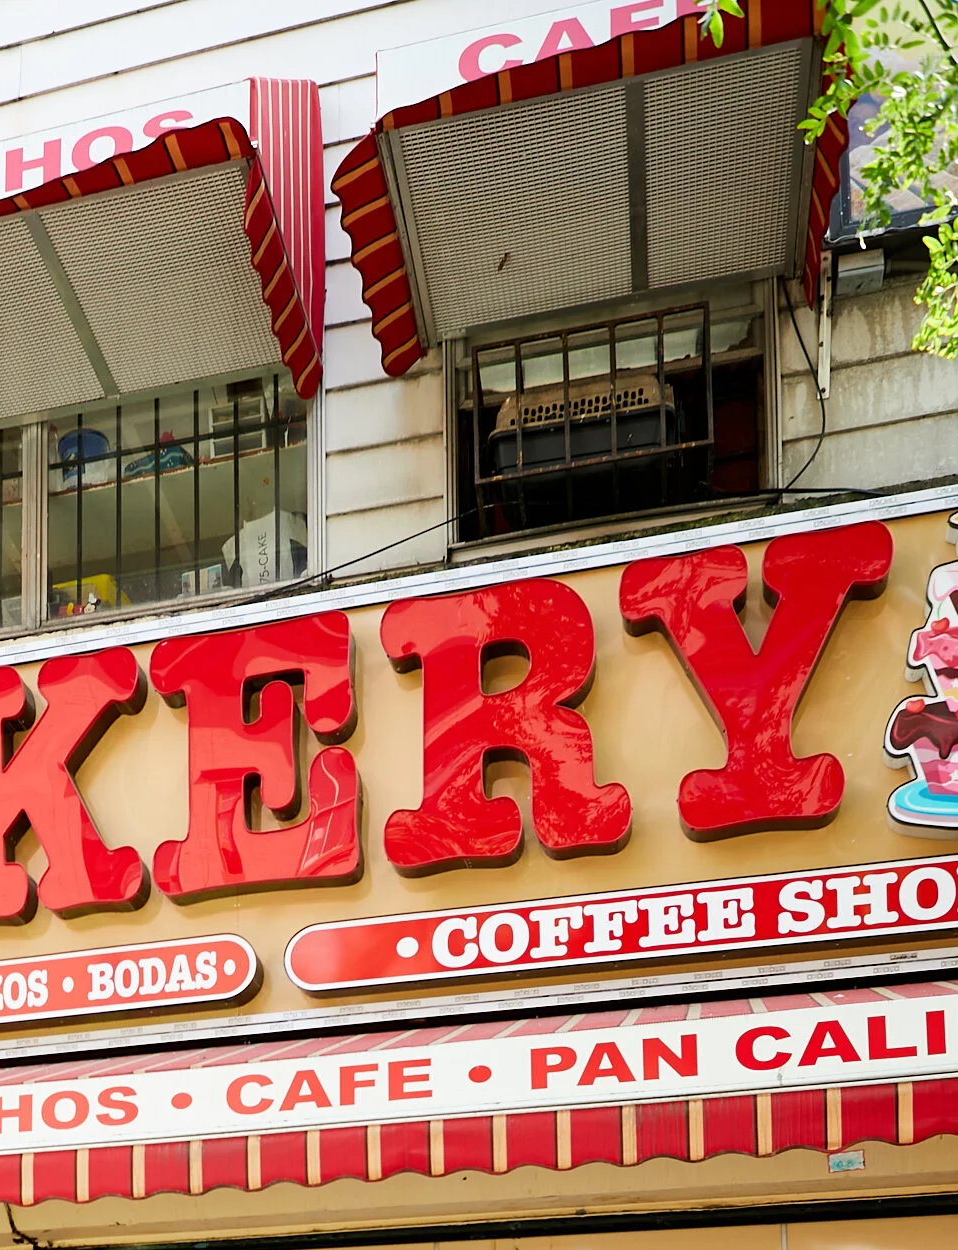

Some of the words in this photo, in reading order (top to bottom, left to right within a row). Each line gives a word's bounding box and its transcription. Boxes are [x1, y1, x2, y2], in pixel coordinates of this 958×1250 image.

[431, 887, 756, 966] COFFEE
[777, 867, 958, 934] SHO
[87, 951, 219, 1000] BODAS
[225, 1058, 434, 1115] CAFE
[529, 1034, 700, 1090] PAN
[735, 1009, 947, 1071] CALI
